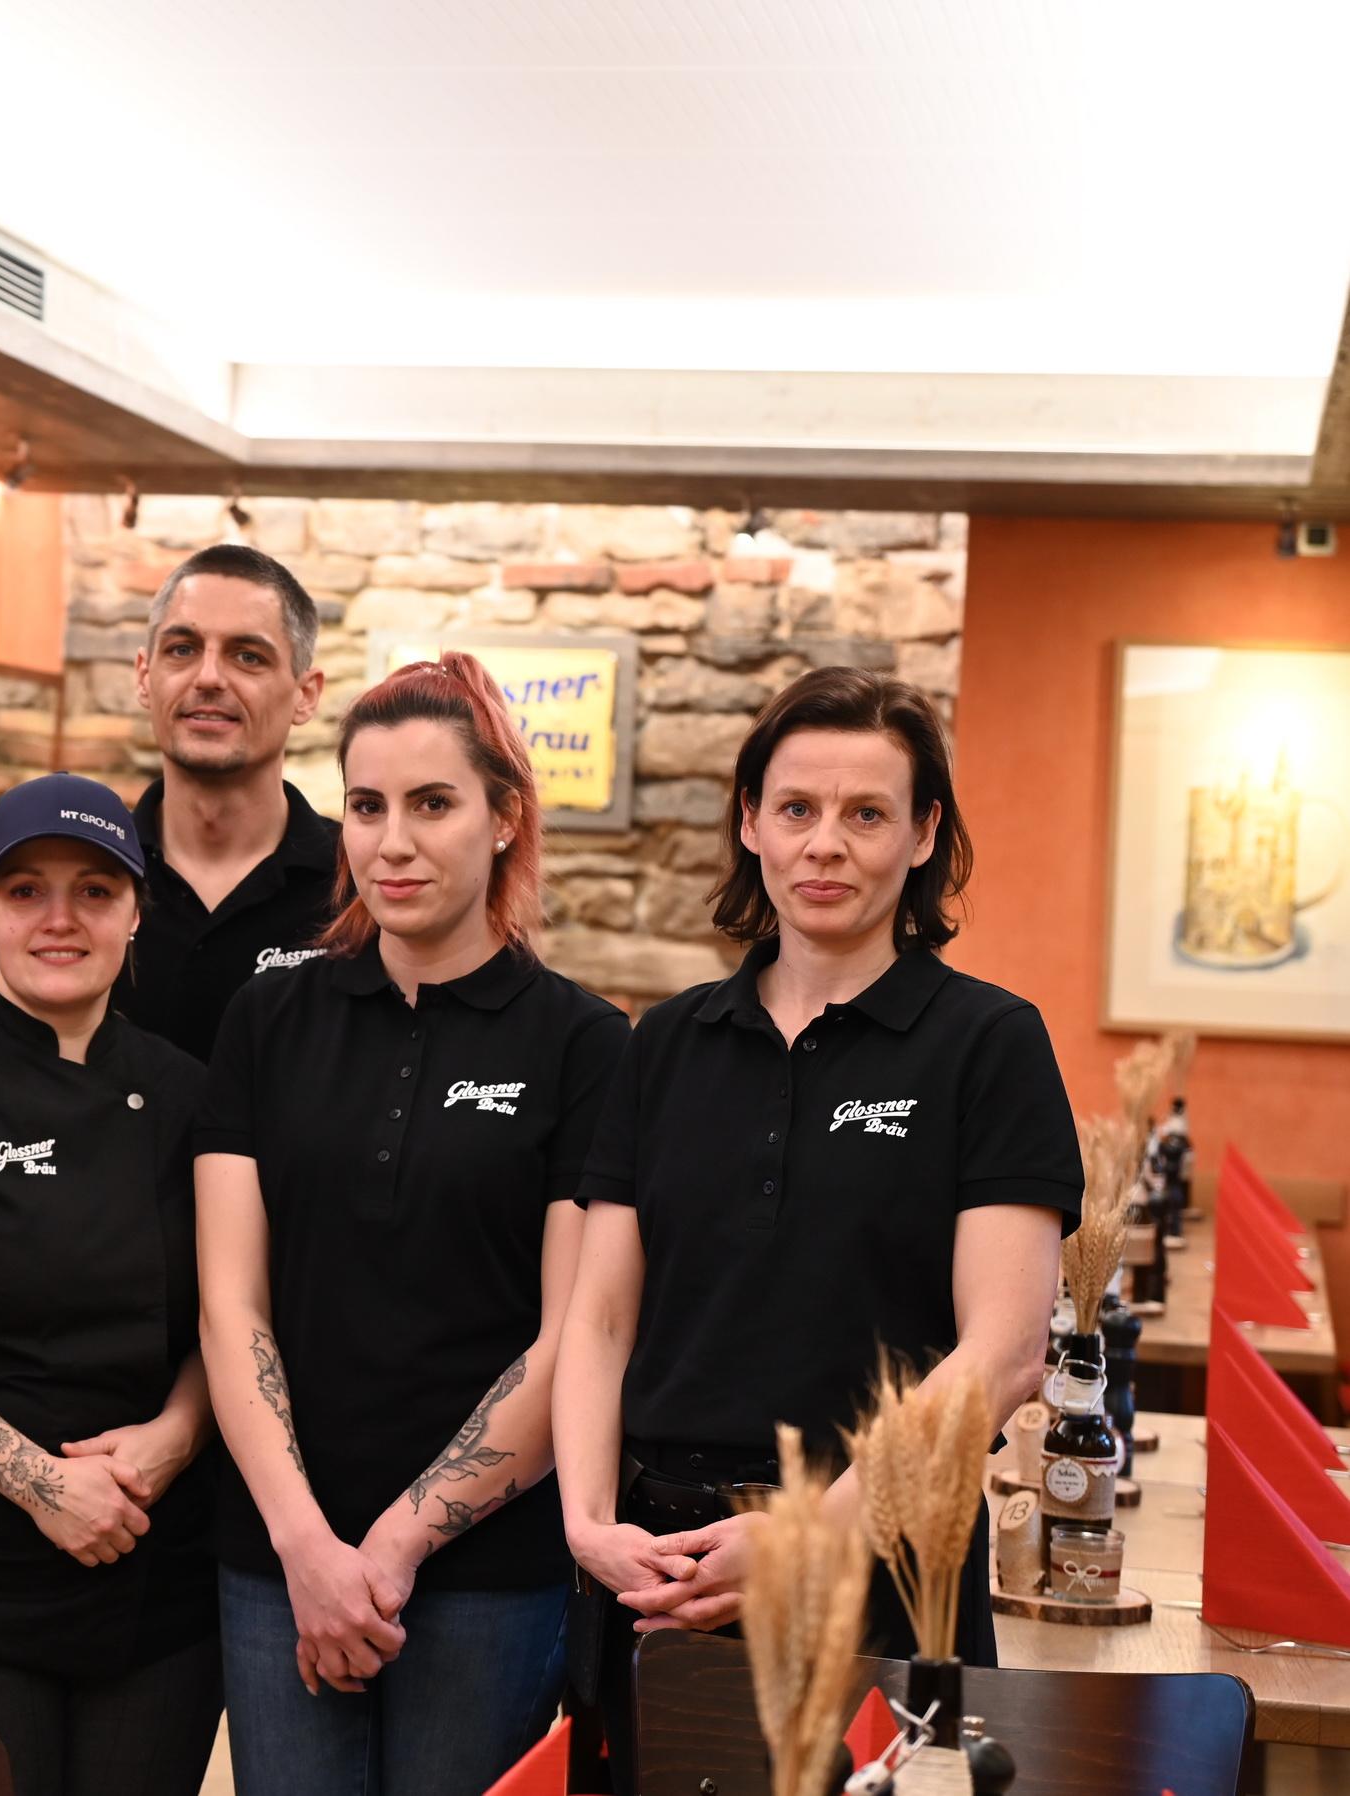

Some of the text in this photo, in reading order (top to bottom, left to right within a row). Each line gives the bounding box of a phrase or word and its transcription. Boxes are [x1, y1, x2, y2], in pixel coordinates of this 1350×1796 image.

[60, 809, 117, 832] HT GROUP
[443, 1080, 527, 1108] Glossner
[476, 1097, 518, 1116] Bräu
[829, 1099, 918, 1132] Glossner
[863, 1117, 909, 1138] Bräu
[23, 1160, 57, 1175] Bräu
[1005, 1500, 1029, 1521] 13
